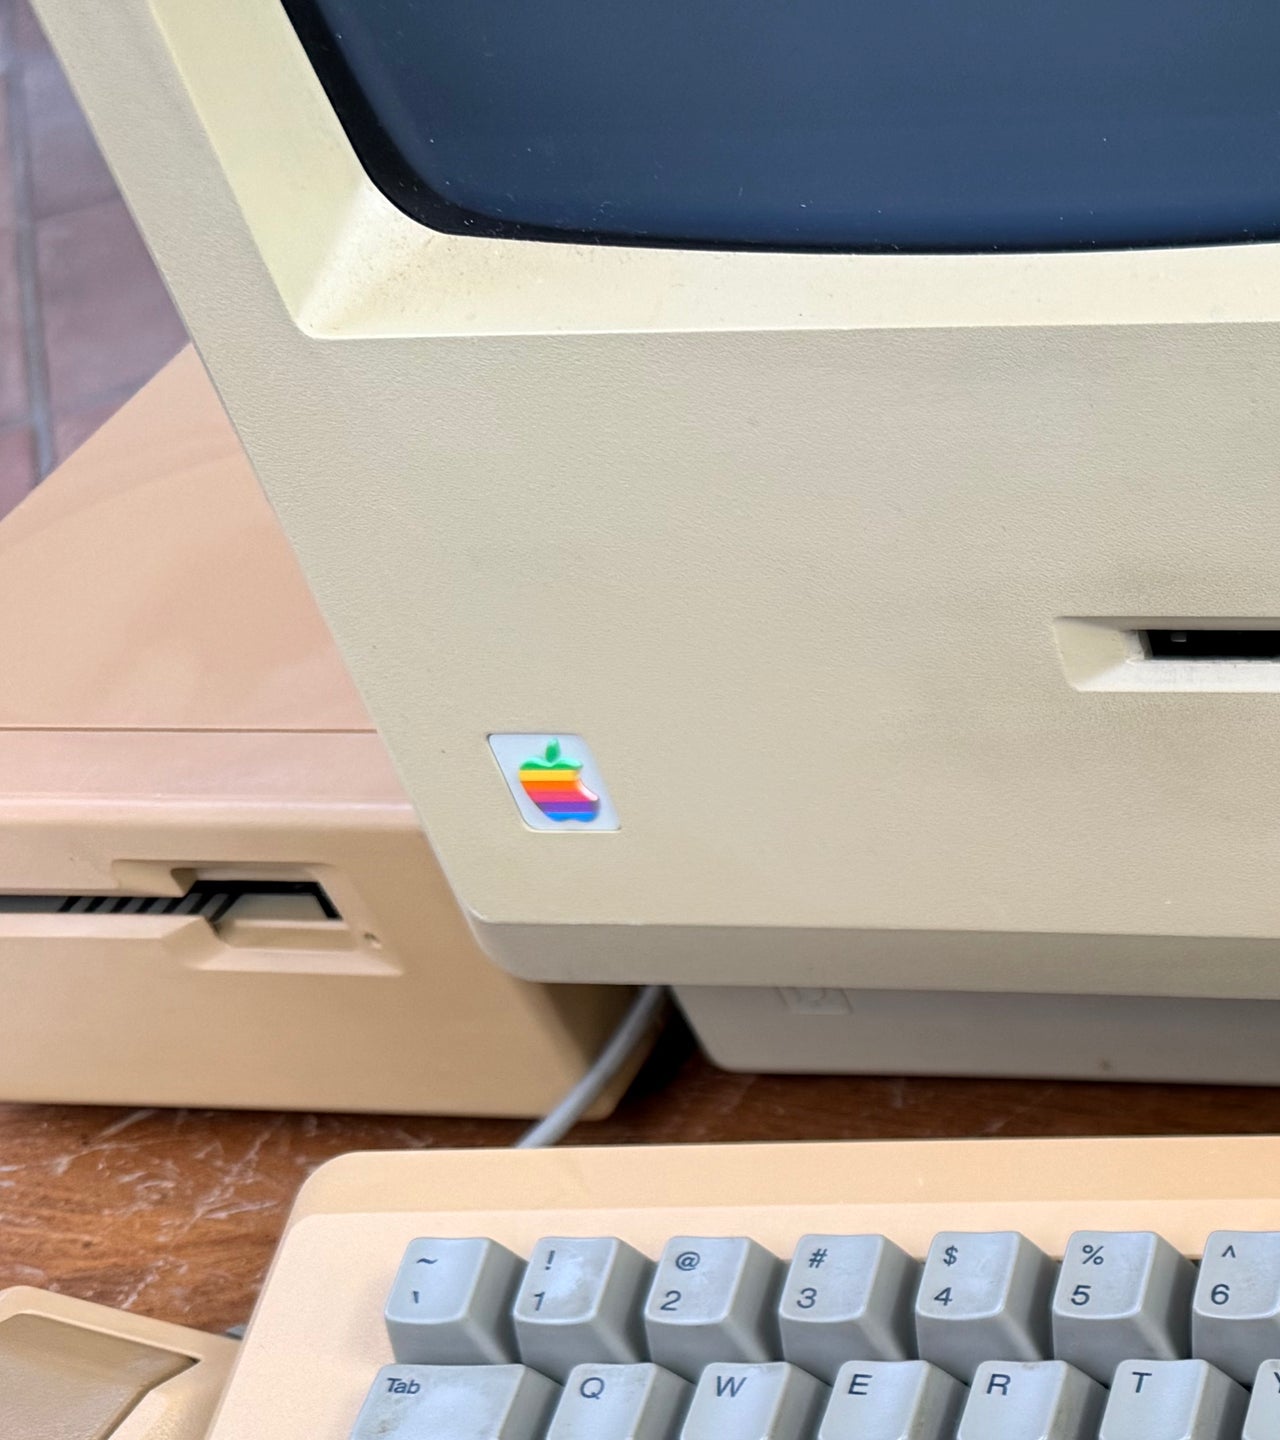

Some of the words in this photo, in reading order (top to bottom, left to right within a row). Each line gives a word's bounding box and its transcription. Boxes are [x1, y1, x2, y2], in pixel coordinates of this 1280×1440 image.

[415, 1257, 439, 1265] ~
[545, 1248, 557, 1271] !
[674, 1250, 701, 1272] @
[807, 1247, 828, 1269] #
[942, 1244, 959, 1268] $
[1081, 1244, 1105, 1266] %
[1220, 1244, 1237, 1259] ^
[533, 1291, 546, 1312] 1
[658, 1289, 682, 1312] 2
[795, 1286, 818, 1310] 3
[932, 1286, 953, 1307] 4
[1069, 1284, 1092, 1307] 5
[1210, 1283, 1231, 1306] 6
[386, 1377, 422, 1395] Tab
[578, 1376, 606, 1401] Q
[715, 1375, 748, 1398] W
[846, 1373, 874, 1396] E
[985, 1372, 1012, 1397] R
[1131, 1370, 1153, 1394] T
